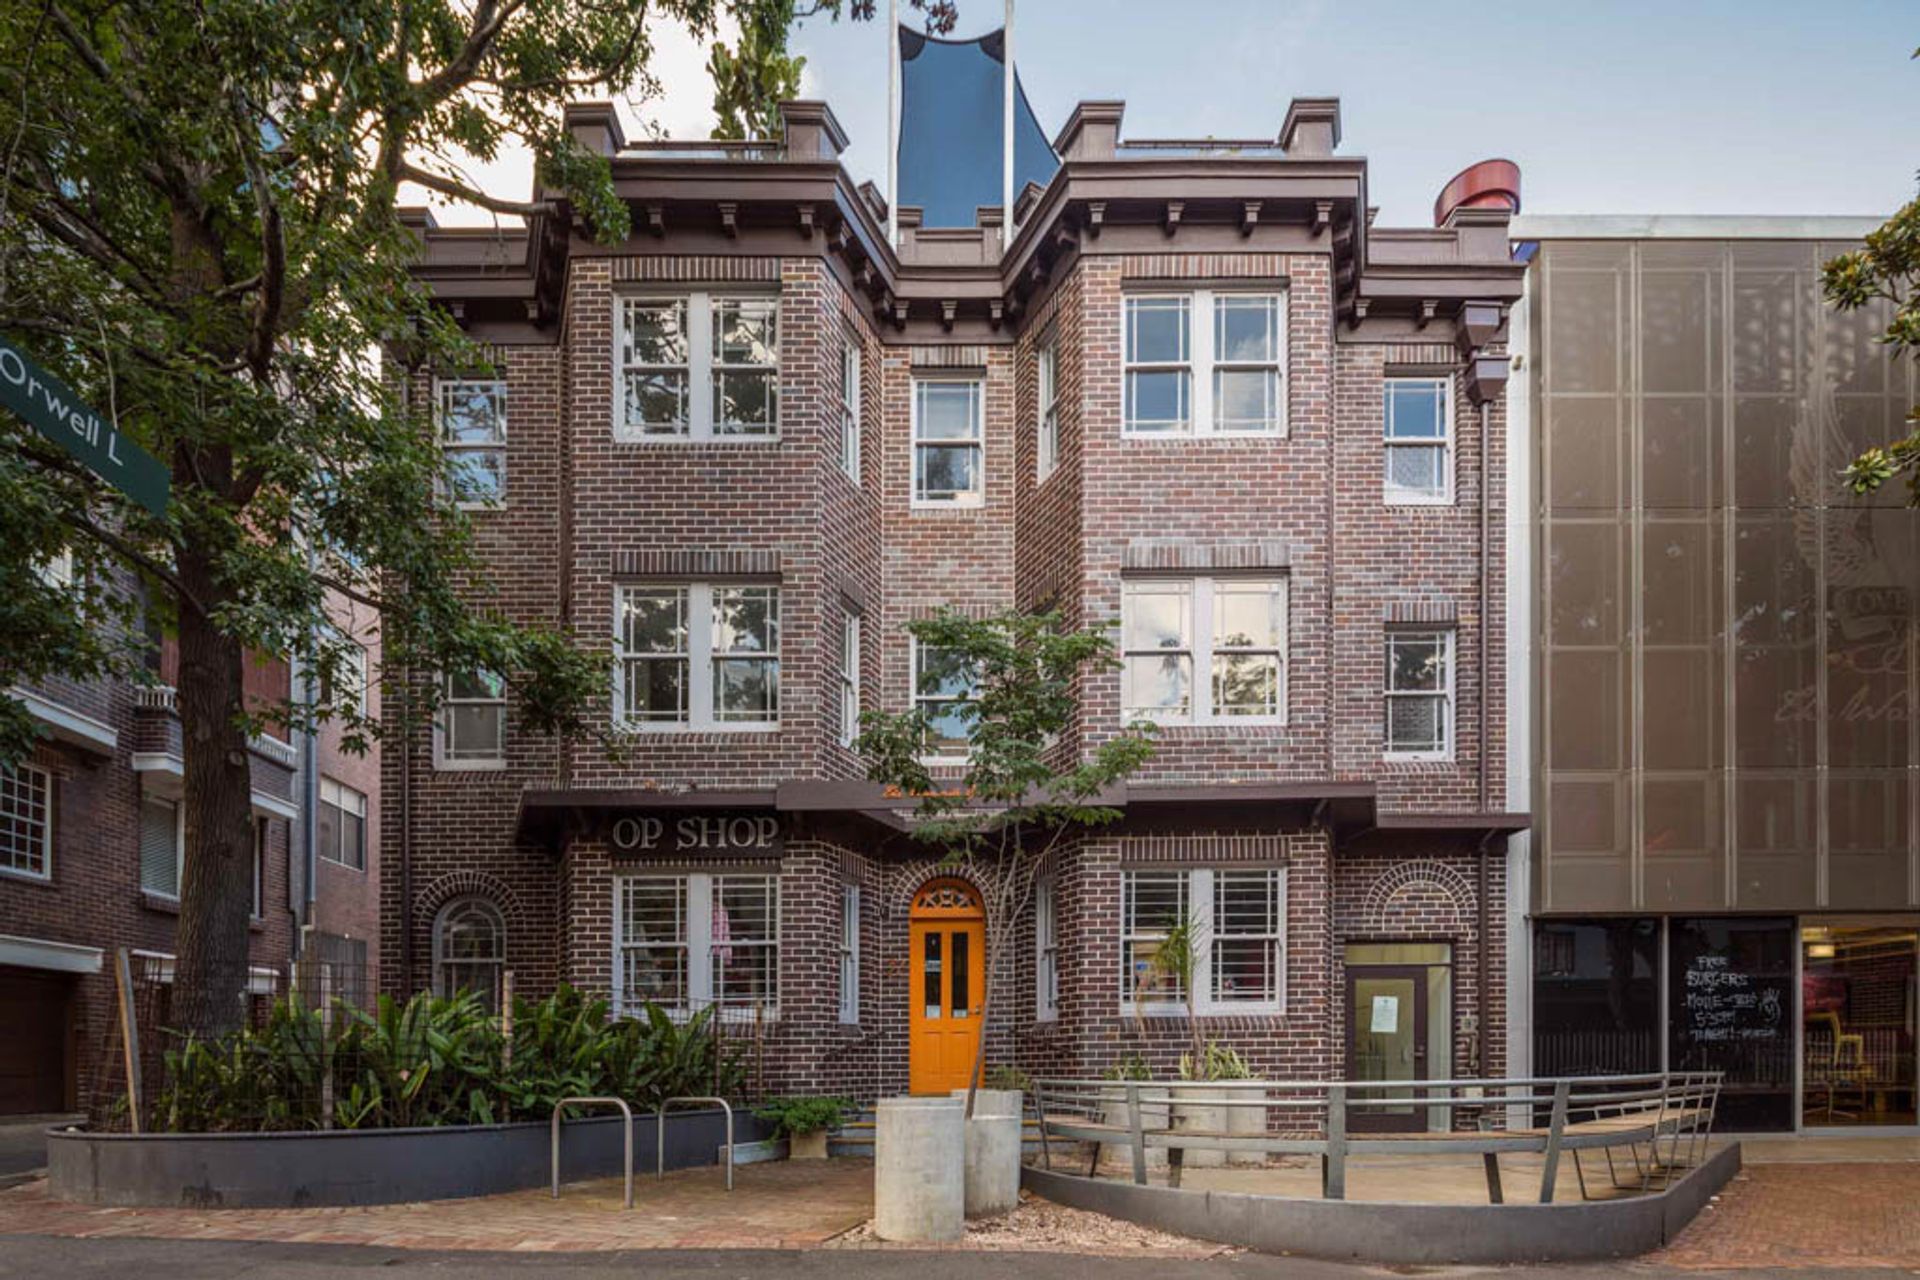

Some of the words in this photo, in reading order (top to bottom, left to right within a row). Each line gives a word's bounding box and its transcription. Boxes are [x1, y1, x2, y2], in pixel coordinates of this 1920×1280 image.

[0, 348, 100, 448] Orwell
[108, 431, 124, 466] L
[613, 817, 663, 849] OP
[676, 816, 779, 850] SHOP
[1696, 956, 1728, 969] FREE
[1686, 971, 1749, 987] BURGERS
